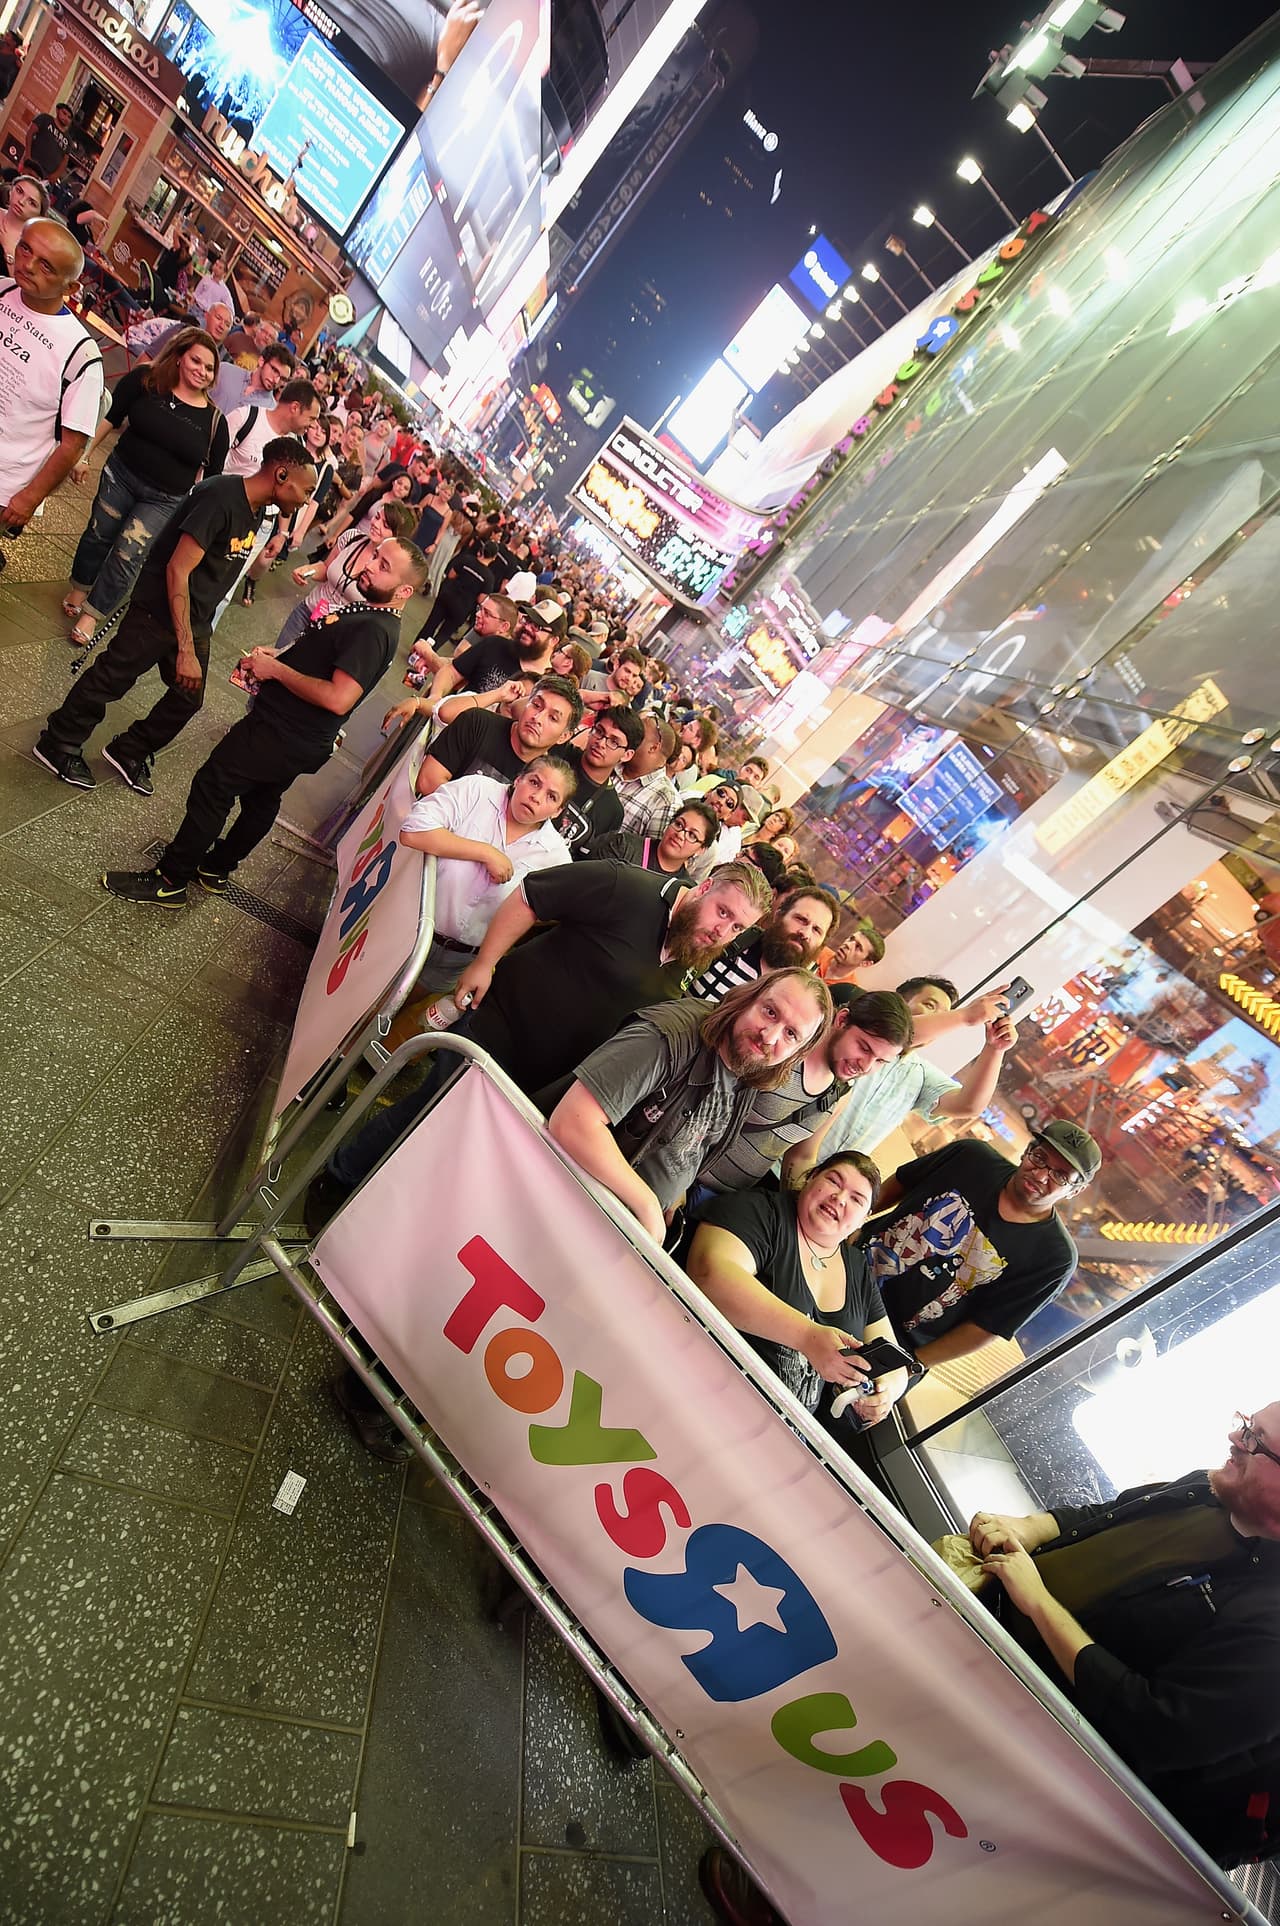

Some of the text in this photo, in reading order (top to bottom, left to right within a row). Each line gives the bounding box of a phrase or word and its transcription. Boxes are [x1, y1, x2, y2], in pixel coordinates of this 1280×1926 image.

[75, 0, 159, 78] uchas
[303, 7, 335, 40] MARQUIS
[308, 0, 342, 36] MARRIOTT
[578, 169, 643, 260] SQUARE
[955, 210, 1049, 312] TOYS
[9, 326, 21, 336] of
[23, 320, 54, 351] States
[874, 359, 922, 408] US
[443, 1234, 692, 1558] TOYS
[770, 1691, 968, 1870] US
